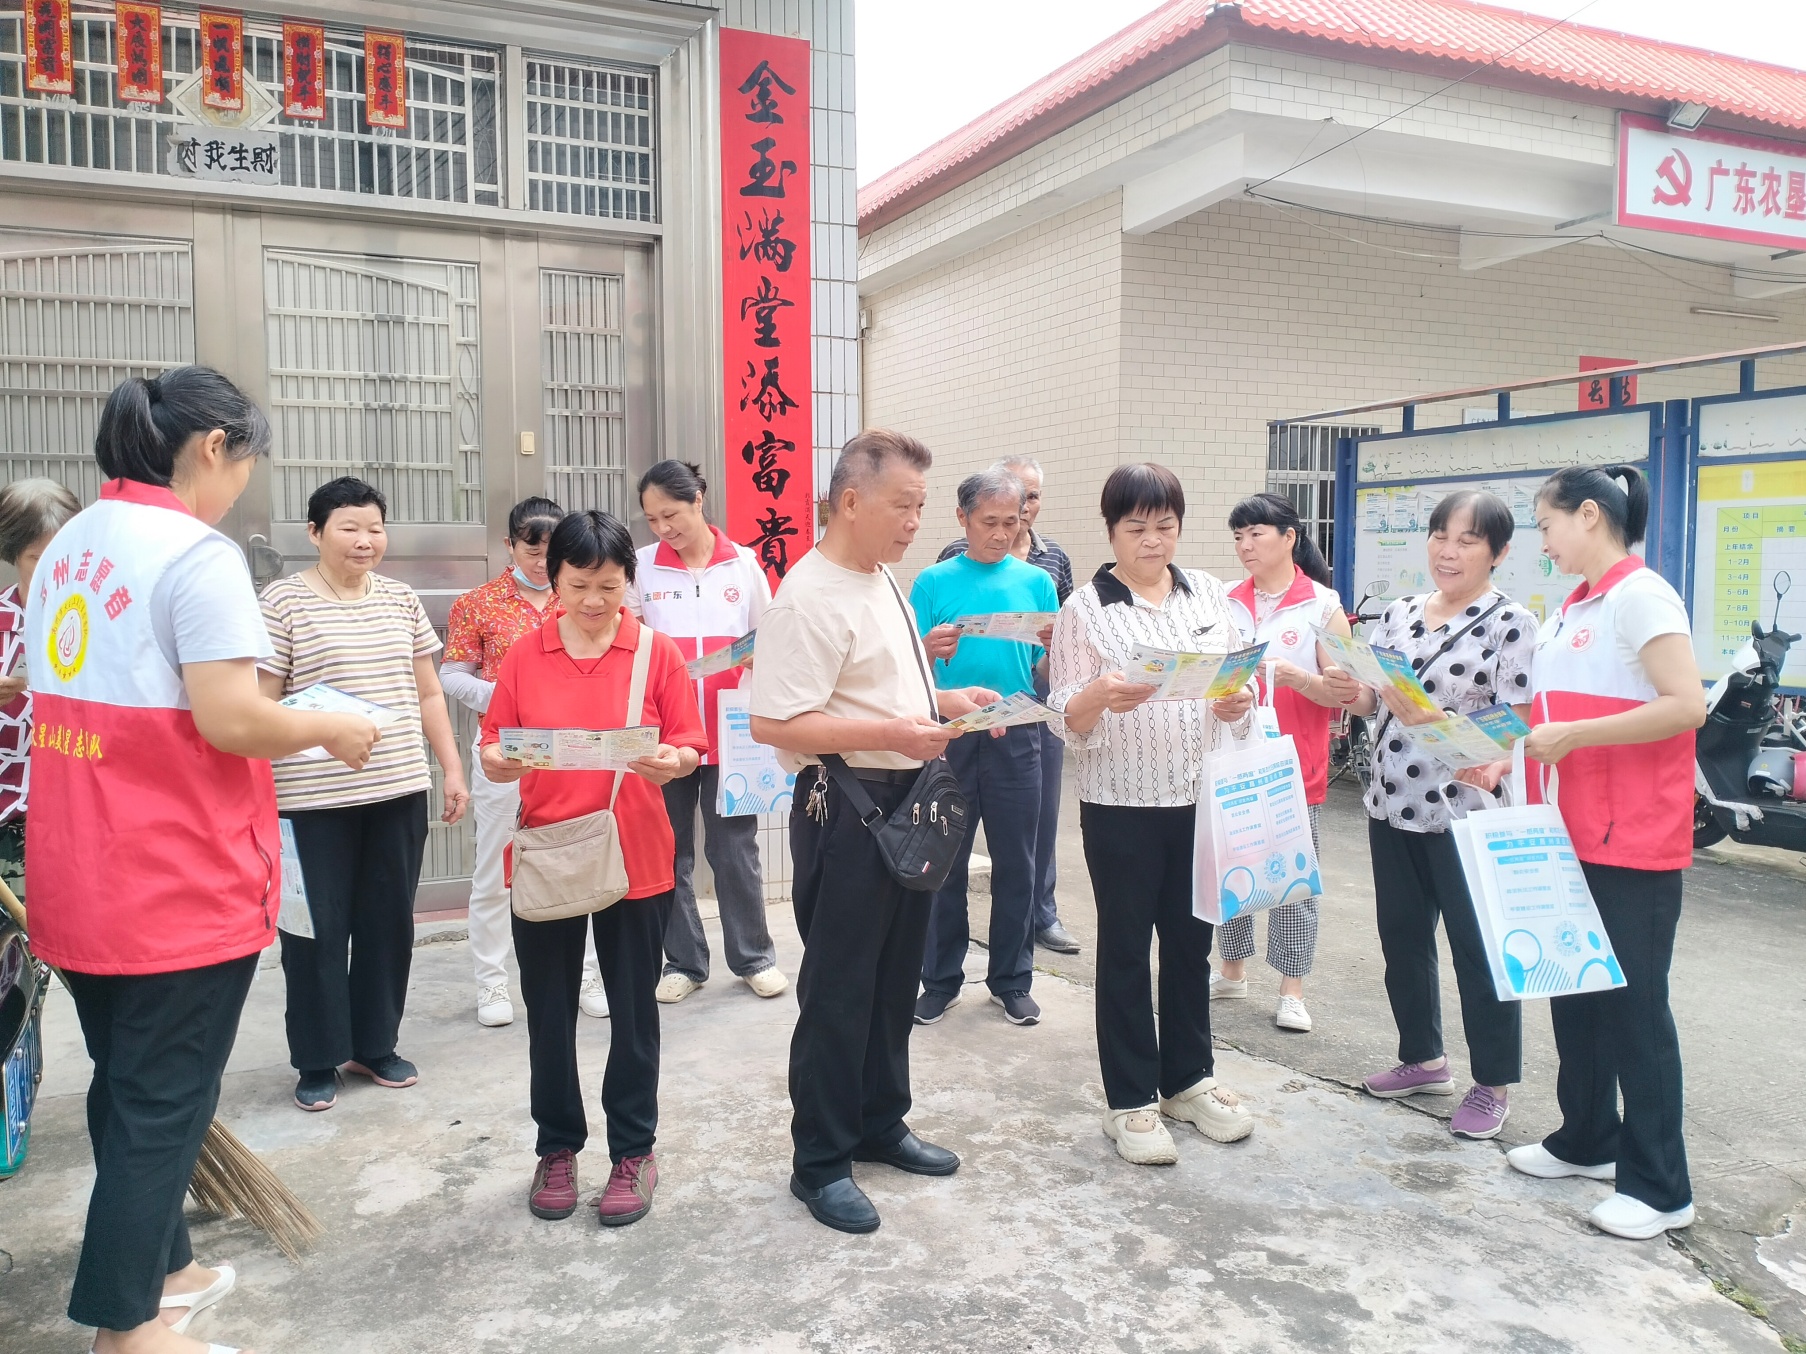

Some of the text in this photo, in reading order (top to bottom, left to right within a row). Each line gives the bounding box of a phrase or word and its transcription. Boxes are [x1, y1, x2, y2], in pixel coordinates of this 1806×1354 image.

[1705, 159, 1806, 220] 广东农垦
[1728, 558, 1750, 566] 1-2月
[1727, 573, 1749, 581] 3-4月
[644, 590, 682, 602] 志愿广东
[1727, 588, 1749, 596] 5-6月
[1726, 604, 1748, 612] 7-8月
[1723, 619, 1750, 627] 9-10月
